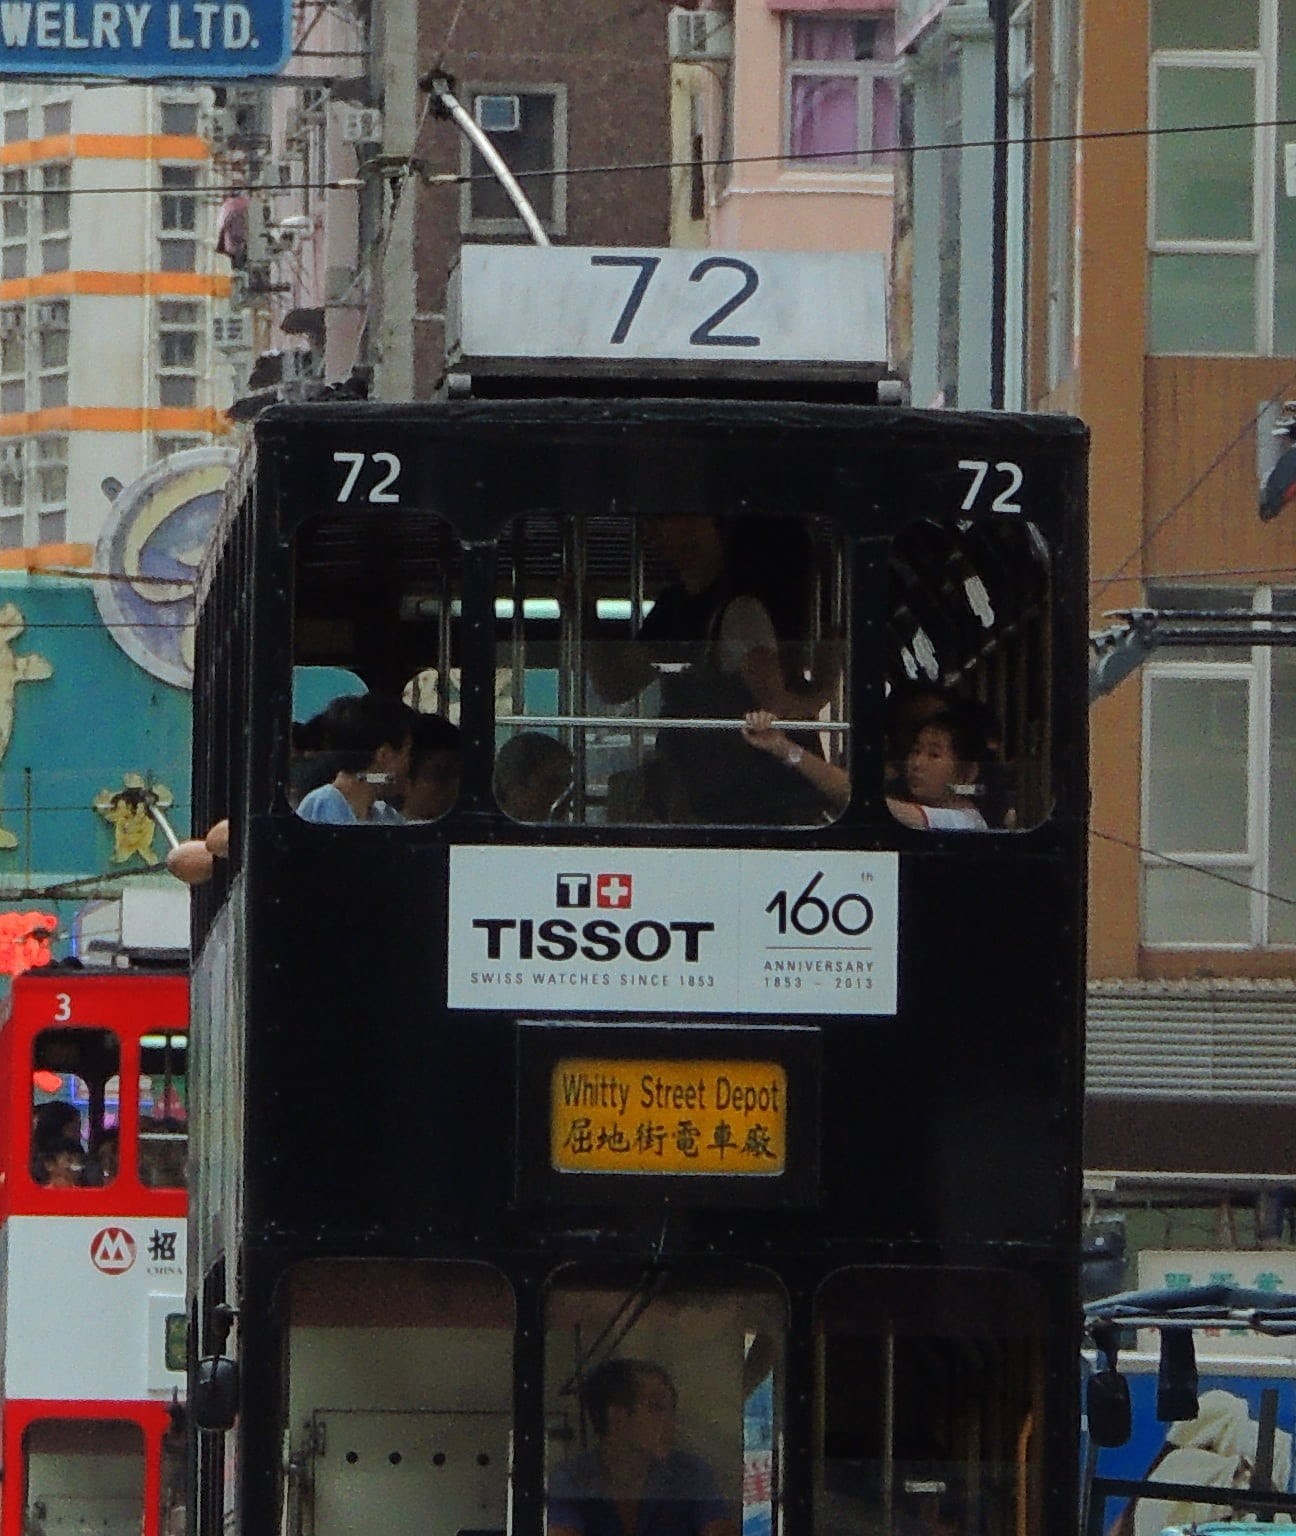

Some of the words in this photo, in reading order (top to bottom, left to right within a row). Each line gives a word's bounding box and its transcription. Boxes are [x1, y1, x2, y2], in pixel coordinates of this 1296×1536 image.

[169, 2, 260, 50] LTD.
[590, 255, 760, 347] 72
[333, 452, 401, 503] 72
[958, 461, 1024, 513] 72
[765, 870, 874, 936] 160
[472, 918, 715, 963] TISSOT
[471, 973, 523, 984] SWISS
[533, 974, 610, 985] WATCHES
[620, 975, 669, 986] SINCE
[679, 976, 715, 987] 1853
[764, 960, 874, 972] ANNIVERSARY
[764, 976, 802, 988] 1853
[835, 978, 873, 989] 2013
[54, 993, 72, 1022] 3
[563, 1073, 630, 1115] Whitty
[640, 1075, 705, 1110] Street
[716, 1076, 779, 1115] Depot
[563, 1117, 777, 1159] 屈地街電車廠
